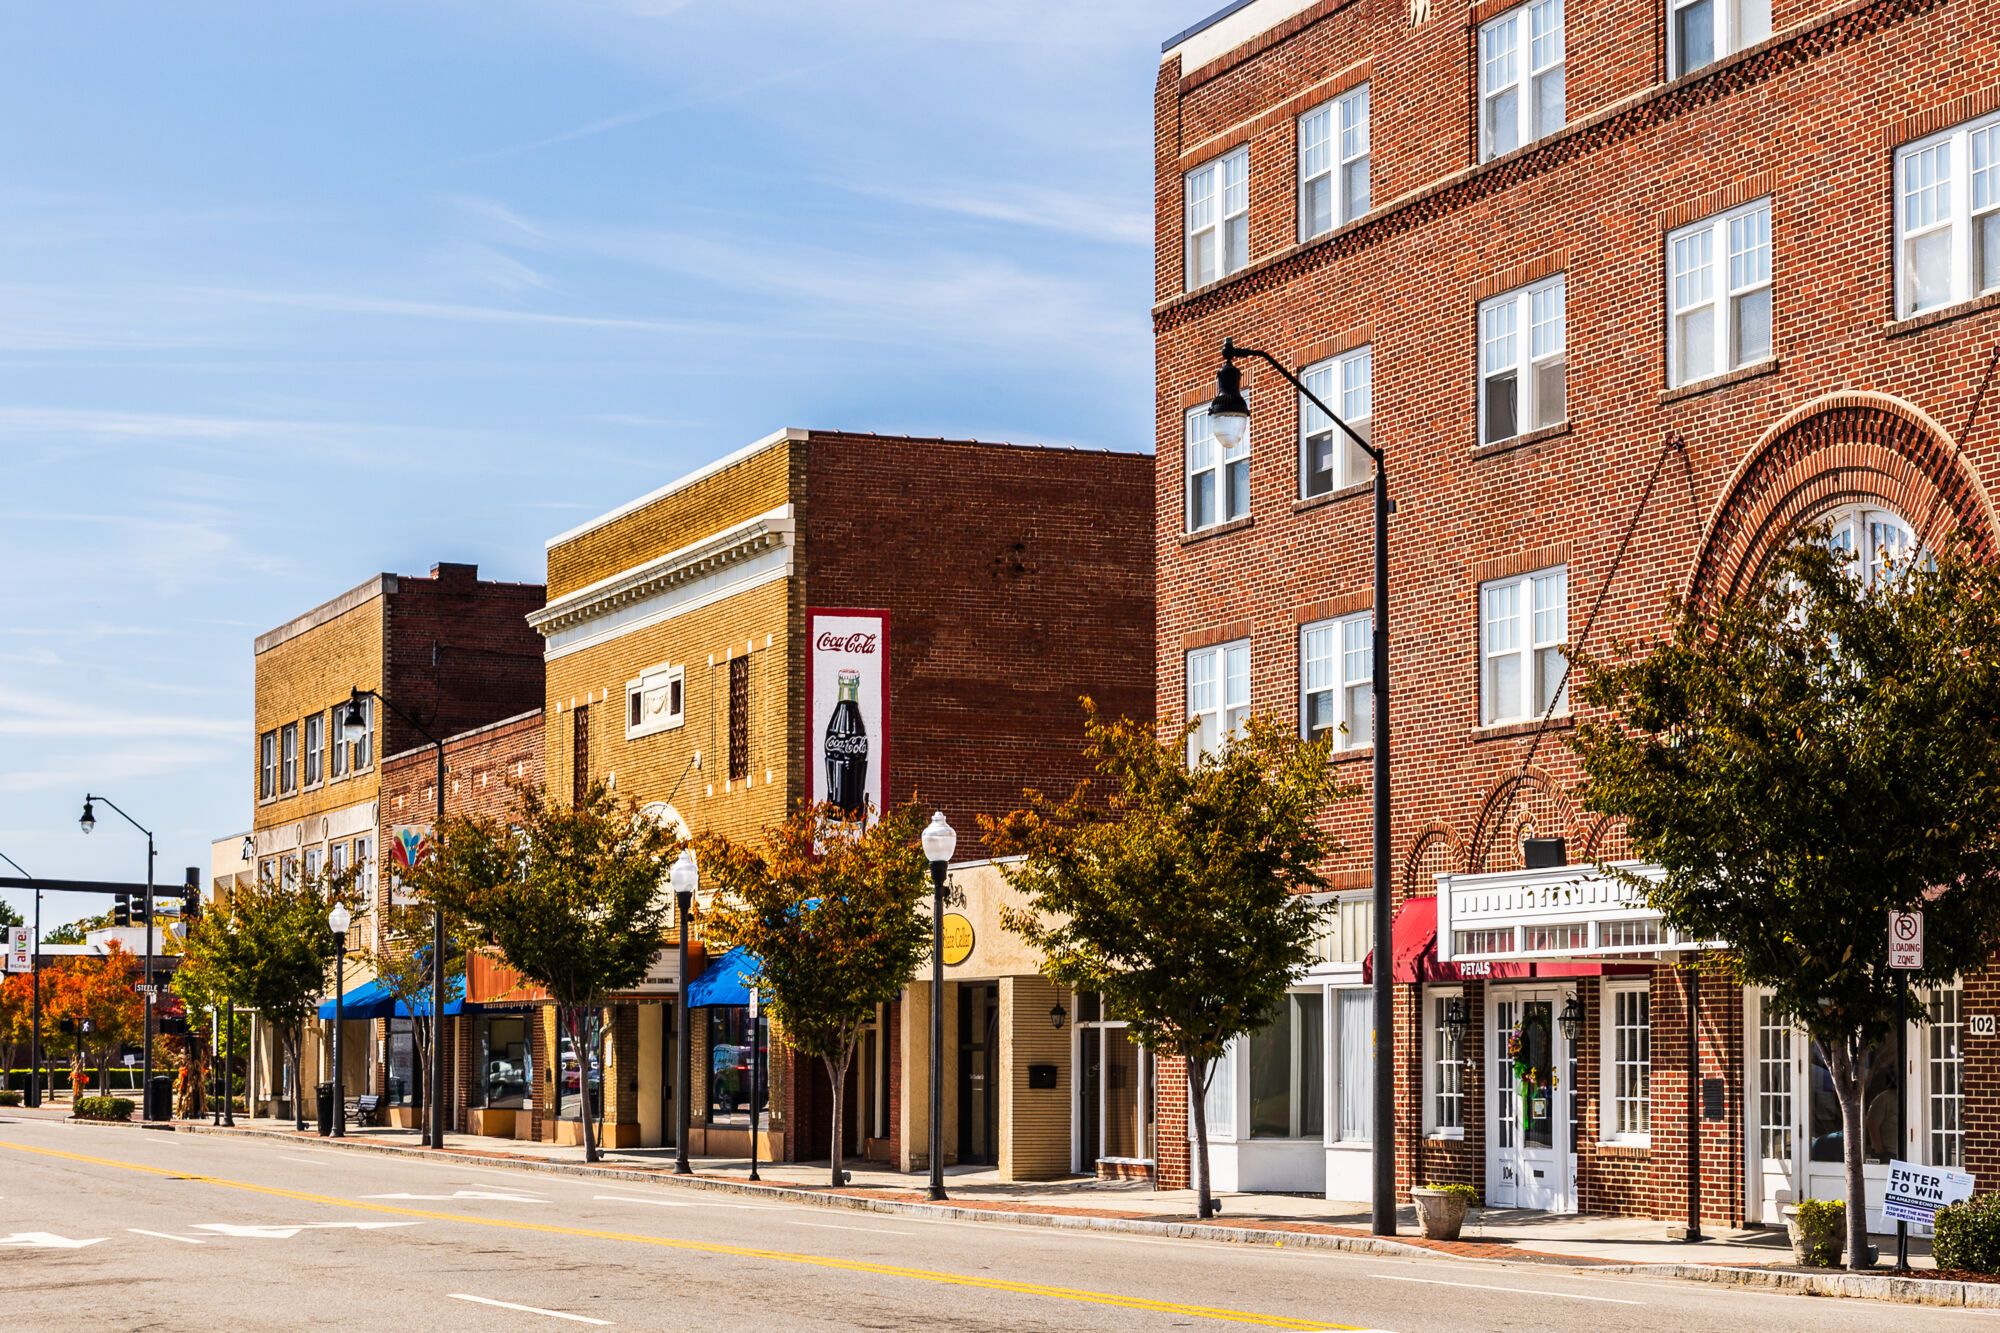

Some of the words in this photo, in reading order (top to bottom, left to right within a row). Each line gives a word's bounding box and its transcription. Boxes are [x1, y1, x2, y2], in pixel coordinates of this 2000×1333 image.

[816, 631, 877, 654] Coca-Cola
[825, 734, 868, 754] Coca-Cola
[14, 934, 27, 963] alive
[1892, 942, 1920, 952] LOADING
[1897, 954, 1915, 964] ZONE
[1460, 961, 1491, 976] PETALS
[137, 984, 159, 992] STEELE
[1971, 1016, 1993, 1033] 102
[1892, 1169, 1940, 1187] ENTER
[1890, 1180, 1910, 1194] TO
[1915, 1186, 1944, 1200] WIN
[1896, 1196, 1919, 1205] AMAZON
[1919, 1200, 1933, 1208] ECHO
[1896, 1212, 1916, 1221] SPECIAL
